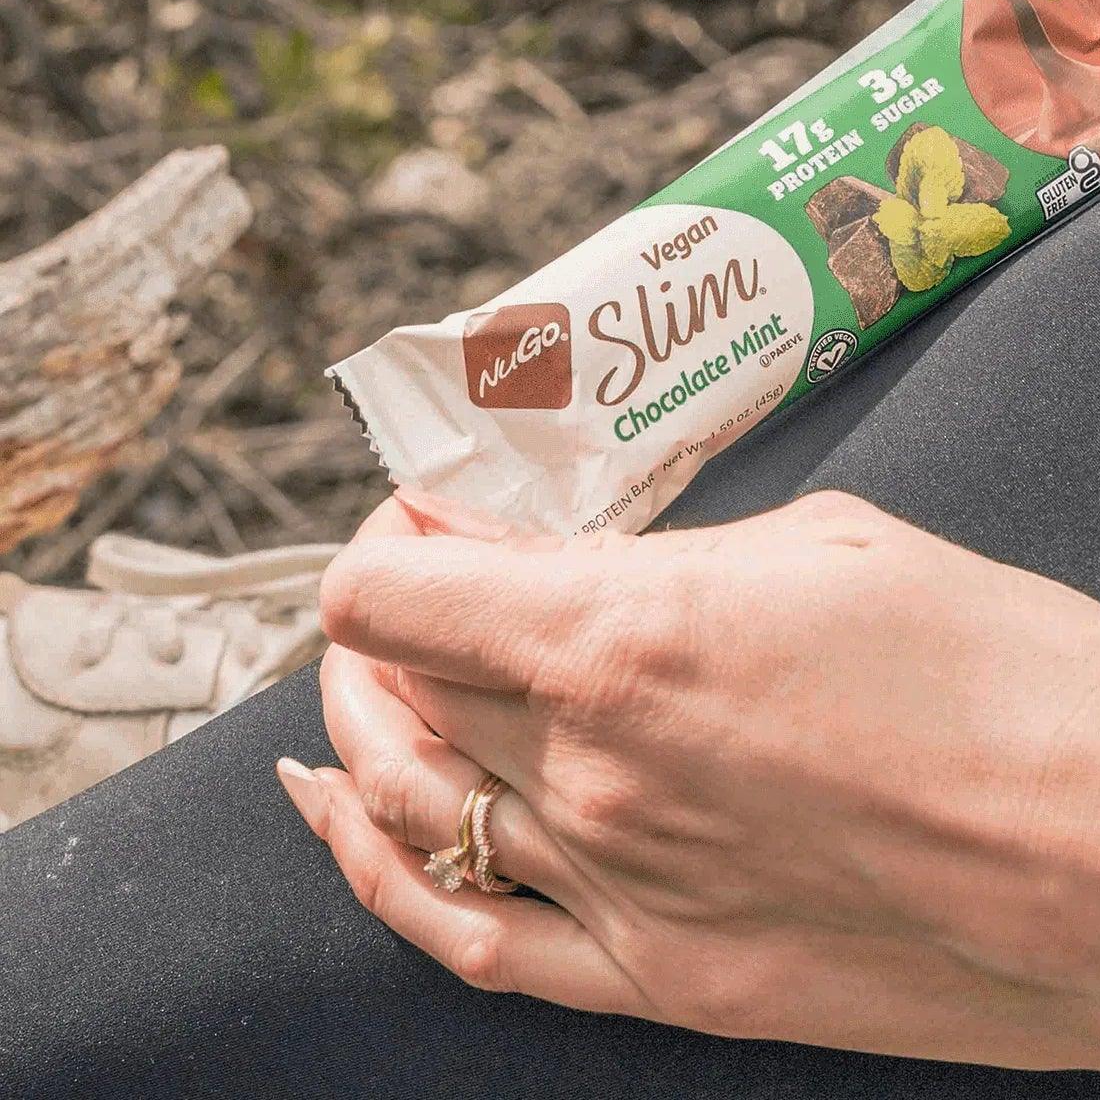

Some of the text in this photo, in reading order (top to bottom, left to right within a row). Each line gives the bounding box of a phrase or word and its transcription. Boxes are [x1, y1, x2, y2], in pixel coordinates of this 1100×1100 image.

[857, 63, 914, 104] 3g
[870, 78, 945, 132] SUGAR
[758, 117, 834, 172] 17g
[766, 129, 865, 201] PROTEIN
[1042, 173, 1079, 205] GLUTEN
[1046, 195, 1069, 217] FREE
[640, 214, 719, 270] Vegan
[588, 258, 759, 407] Slim
[770, 333, 804, 360] PAREVE
[613, 313, 788, 443] Chocolate Mint
[662, 450, 684, 472] Net
[755, 383, 784, 411] (45g)
[581, 473, 656, 535] PROTEIN BAR
